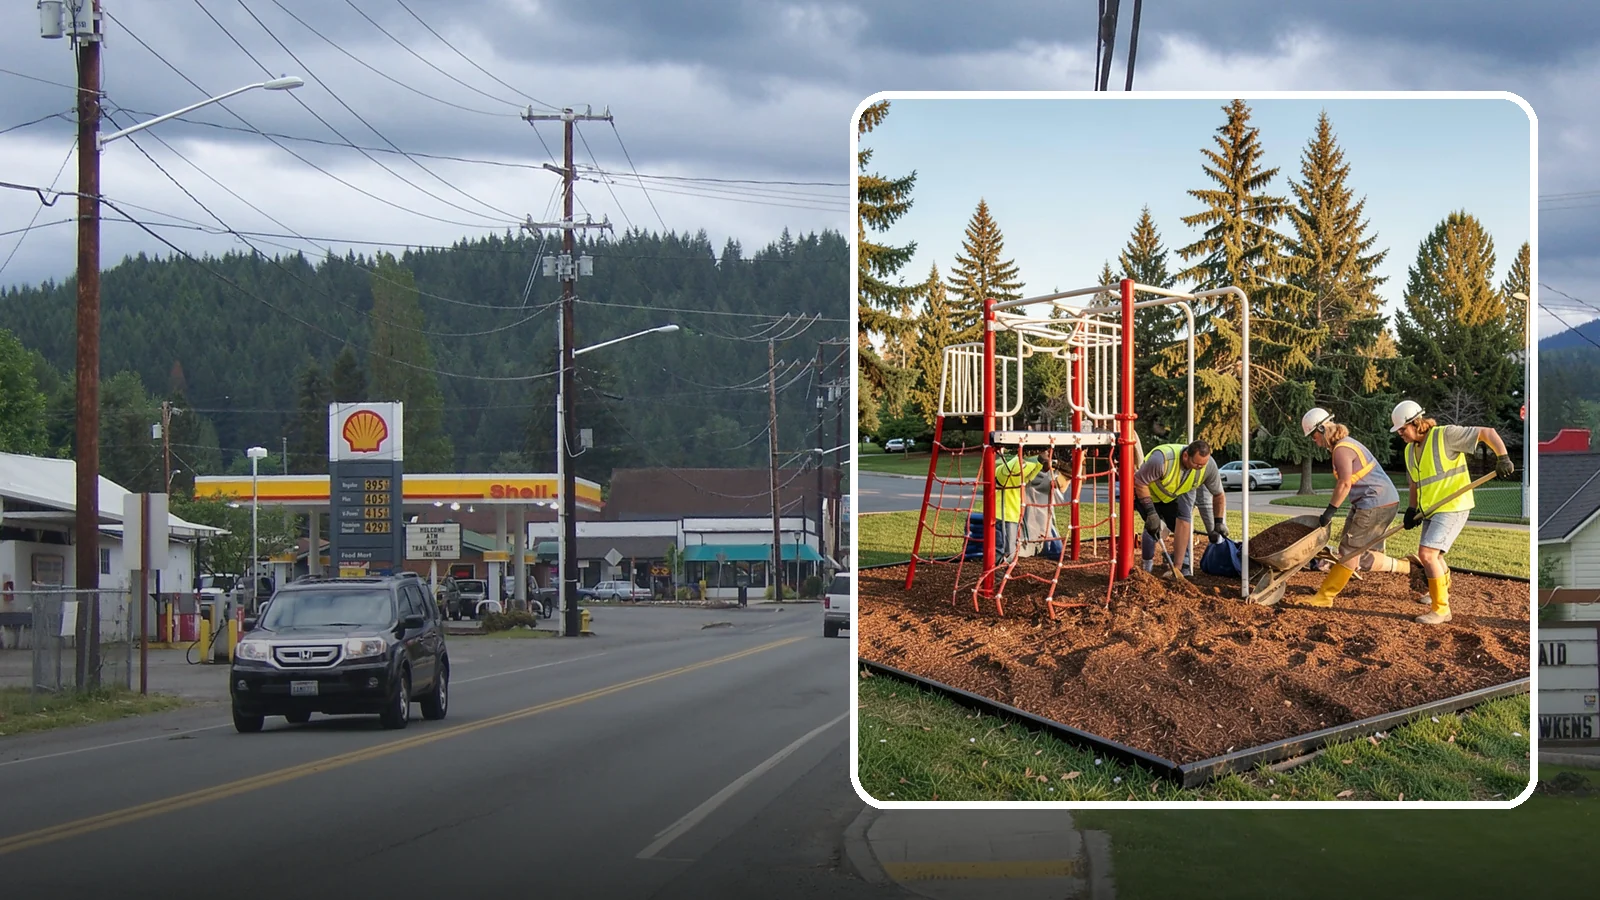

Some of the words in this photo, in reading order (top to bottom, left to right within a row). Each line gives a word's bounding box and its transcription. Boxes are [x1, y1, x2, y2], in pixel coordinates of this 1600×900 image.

[366, 480, 383, 490] 395
[490, 484, 547, 499] Shell
[366, 494, 383, 504] 405
[366, 508, 383, 518] 415
[366, 522, 383, 532] 429
[1538, 643, 1566, 666] AID
